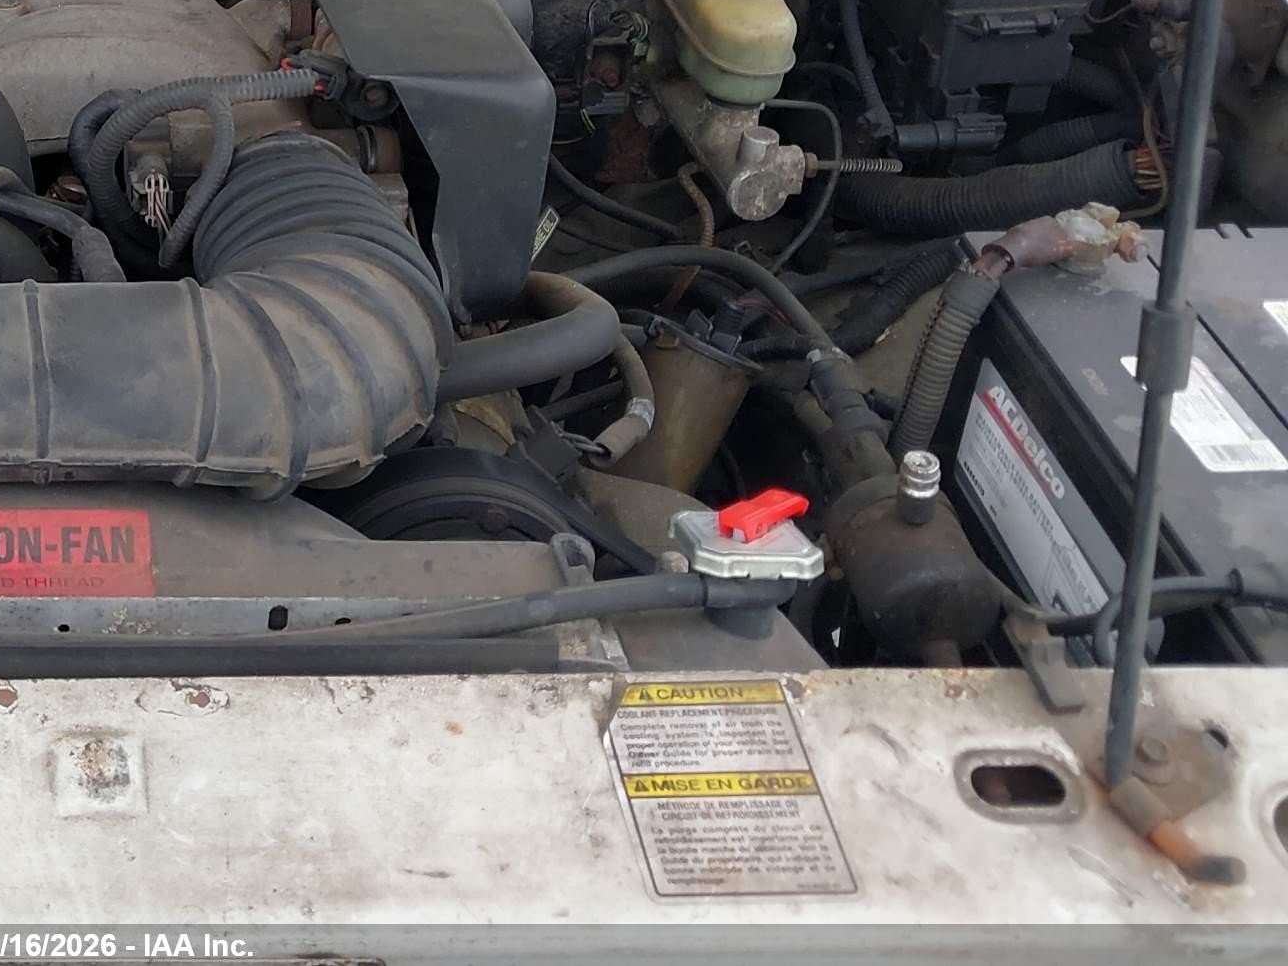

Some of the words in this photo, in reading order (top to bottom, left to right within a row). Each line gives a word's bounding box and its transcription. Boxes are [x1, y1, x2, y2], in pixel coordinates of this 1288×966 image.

[988, 386, 1065, 499] ACDelco
[23, 576, 105, 589] THREAD
[656, 687, 744, 700] CAUTION
[617, 710, 657, 719] COOLANT
[651, 780, 700, 791] MISE
[706, 779, 732, 790] EN
[738, 777, 810, 789] GARDE
